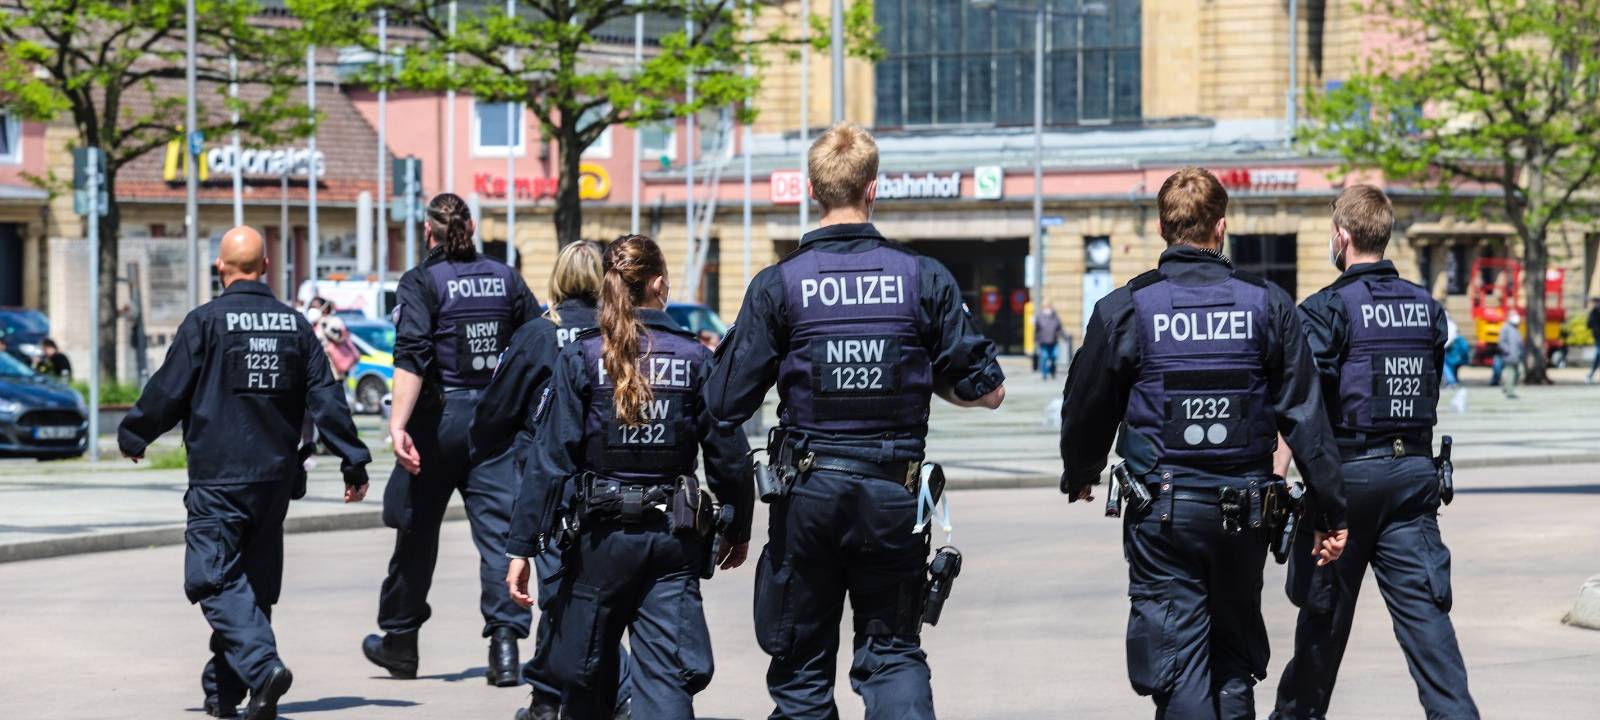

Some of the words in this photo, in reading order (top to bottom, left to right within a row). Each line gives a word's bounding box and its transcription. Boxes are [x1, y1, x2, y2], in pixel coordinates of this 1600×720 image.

[775, 176, 801, 197] DB
[877, 171, 960, 198] bahnhof
[447, 278, 507, 299] POLIZEI
[801, 276, 904, 308] POLIZEI
[226, 312, 297, 331] POLIZEI
[1154, 311, 1252, 342] POLIZEI
[1361, 304, 1431, 328] POLIZEI
[466, 322, 498, 338] NRW
[249, 338, 277, 352] NRW
[468, 338, 497, 353] 1232
[827, 340, 885, 363] NRW
[244, 354, 279, 370] 1232
[598, 358, 692, 387] PIZEI
[1385, 357, 1423, 375] NRW
[248, 373, 279, 388] FLT
[832, 367, 882, 389] 1232
[1386, 378, 1420, 396] 1232
[1182, 397, 1230, 419] 1232
[1390, 400, 1413, 417] RH
[618, 423, 665, 444] 1232
